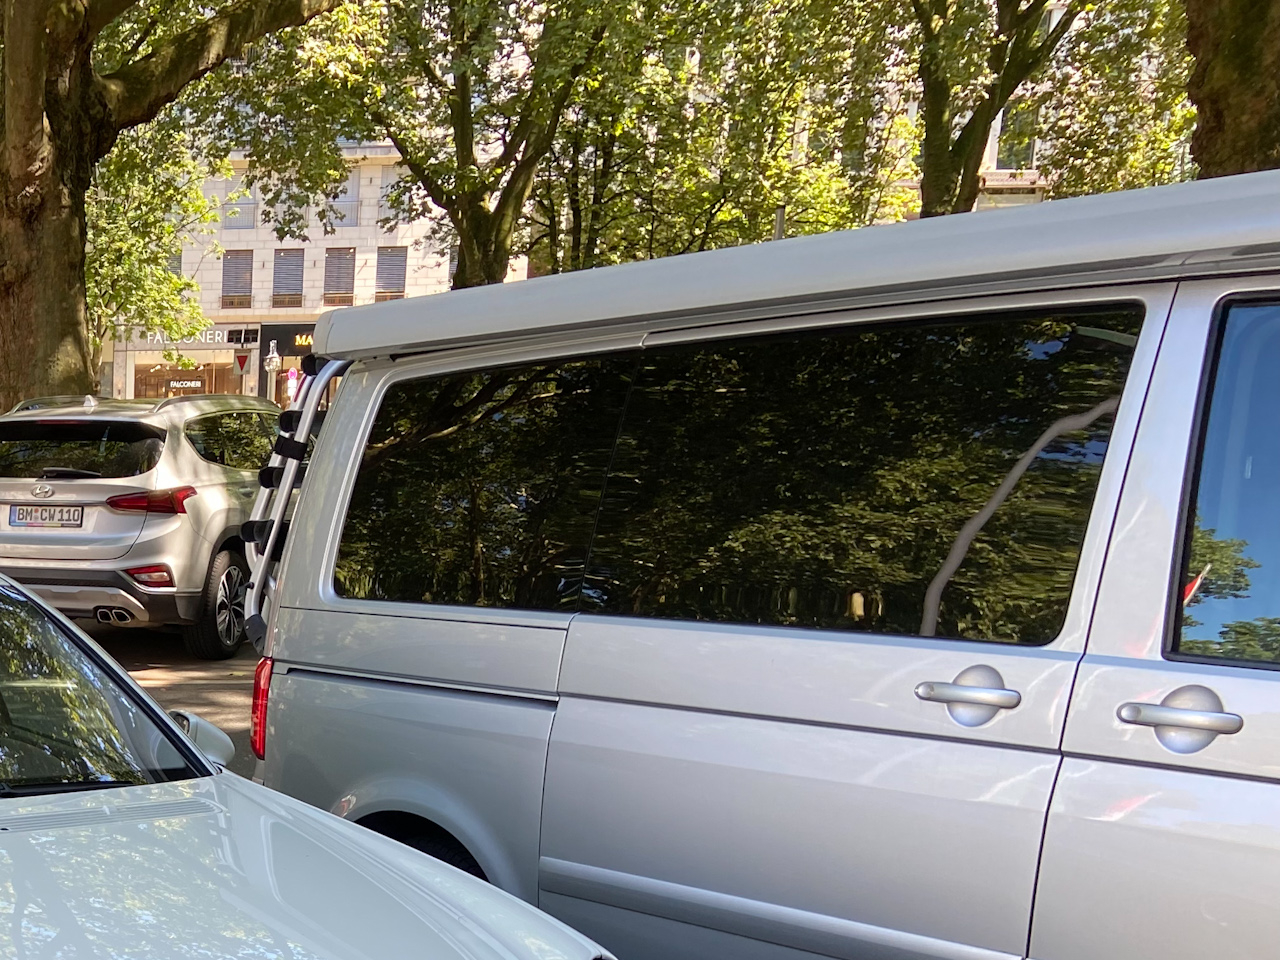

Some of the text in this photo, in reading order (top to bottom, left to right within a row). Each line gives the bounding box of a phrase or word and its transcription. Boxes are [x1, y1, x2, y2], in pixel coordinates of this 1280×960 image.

[17, 508, 80, 522] BM CW 110
